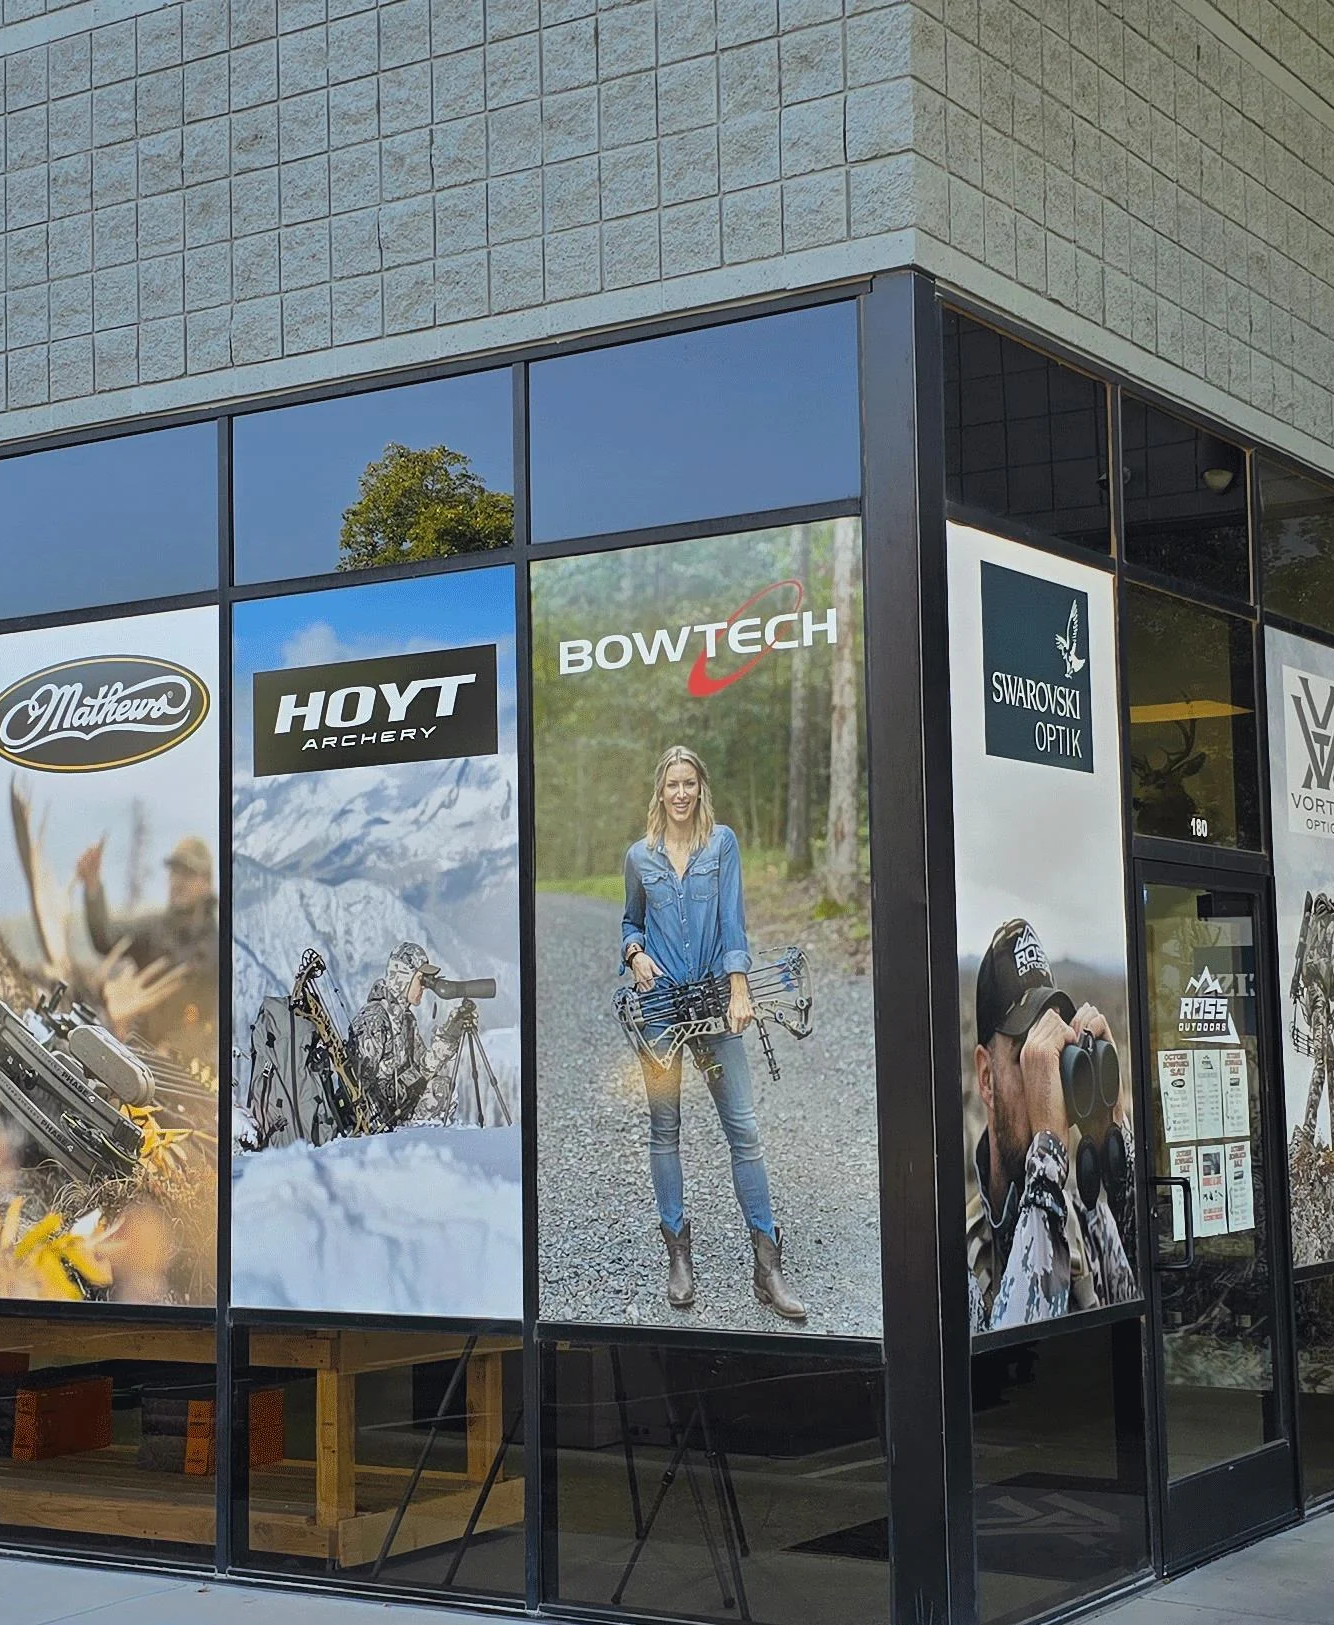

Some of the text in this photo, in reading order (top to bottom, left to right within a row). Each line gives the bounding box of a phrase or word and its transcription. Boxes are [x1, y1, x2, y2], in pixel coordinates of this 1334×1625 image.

[559, 608, 837, 675] BOWTECH
[274, 673, 476, 734] HOYT
[992, 671, 1080, 719] SWAROVSKI
[0, 675, 192, 747] Mathews
[302, 726, 437, 750] ARCHERY
[1035, 721, 1082, 758] OPTIK
[1190, 817, 1208, 837] 180
[1015, 945, 1046, 969] ROS
[1179, 997, 1228, 1020] ROSS
[1178, 1022, 1227, 1032] OUTDOORS
